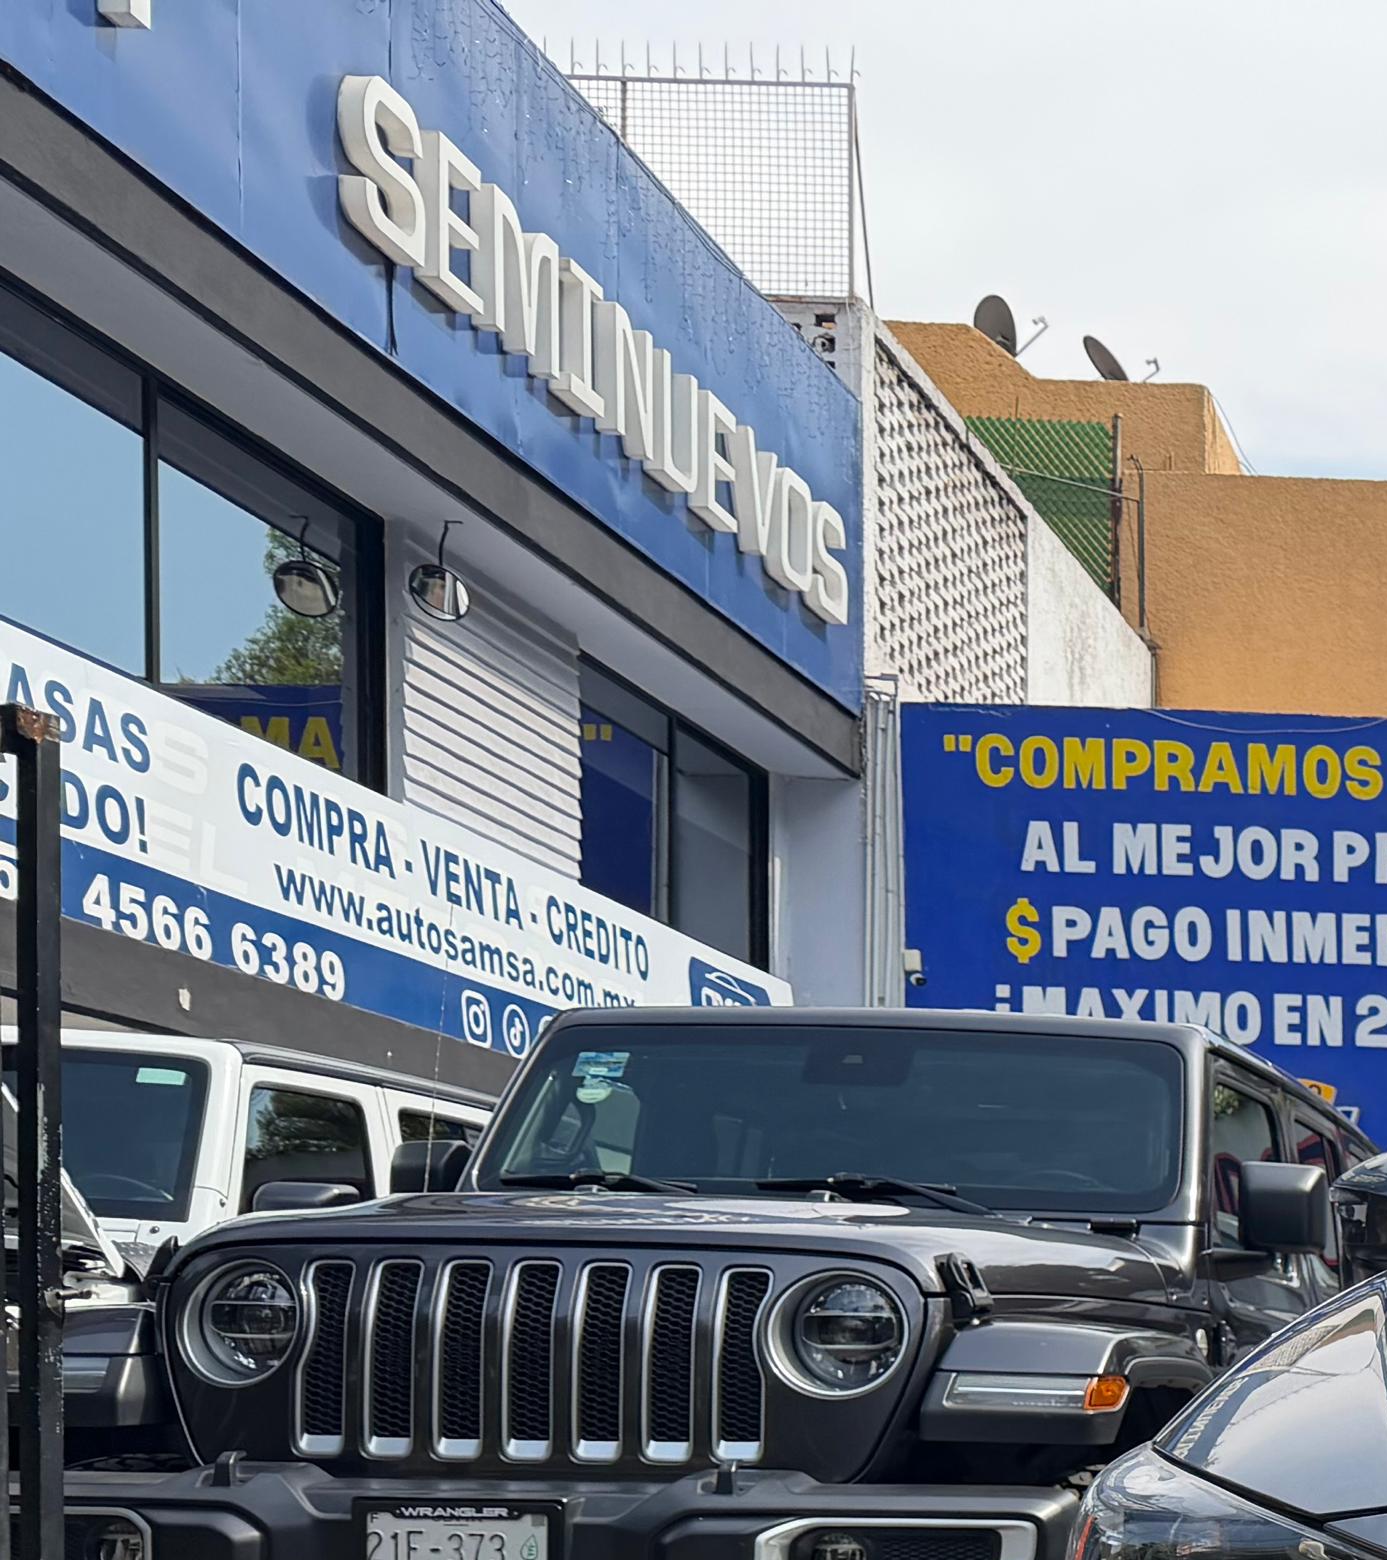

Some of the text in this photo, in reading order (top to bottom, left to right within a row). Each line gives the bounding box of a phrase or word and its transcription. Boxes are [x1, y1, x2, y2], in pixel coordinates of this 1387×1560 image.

[337, 74, 848, 624] SEMINUEVOS
[943, 732, 1383, 801] "COMPRAMOS
[237, 763, 396, 879] COMPRA
[420, 839, 523, 930] VENTA
[546, 895, 649, 981] CREDITO
[1021, 821, 1095, 874] AL
[1112, 823, 1319, 881] MEJOR
[82, 874, 212, 960] 4566
[231, 922, 345, 1001] 6389
[1052, 905, 1211, 961] PAGO
[1274, 994, 1343, 1048] EN
[401, 1507, 508, 1517] WRANGLER
